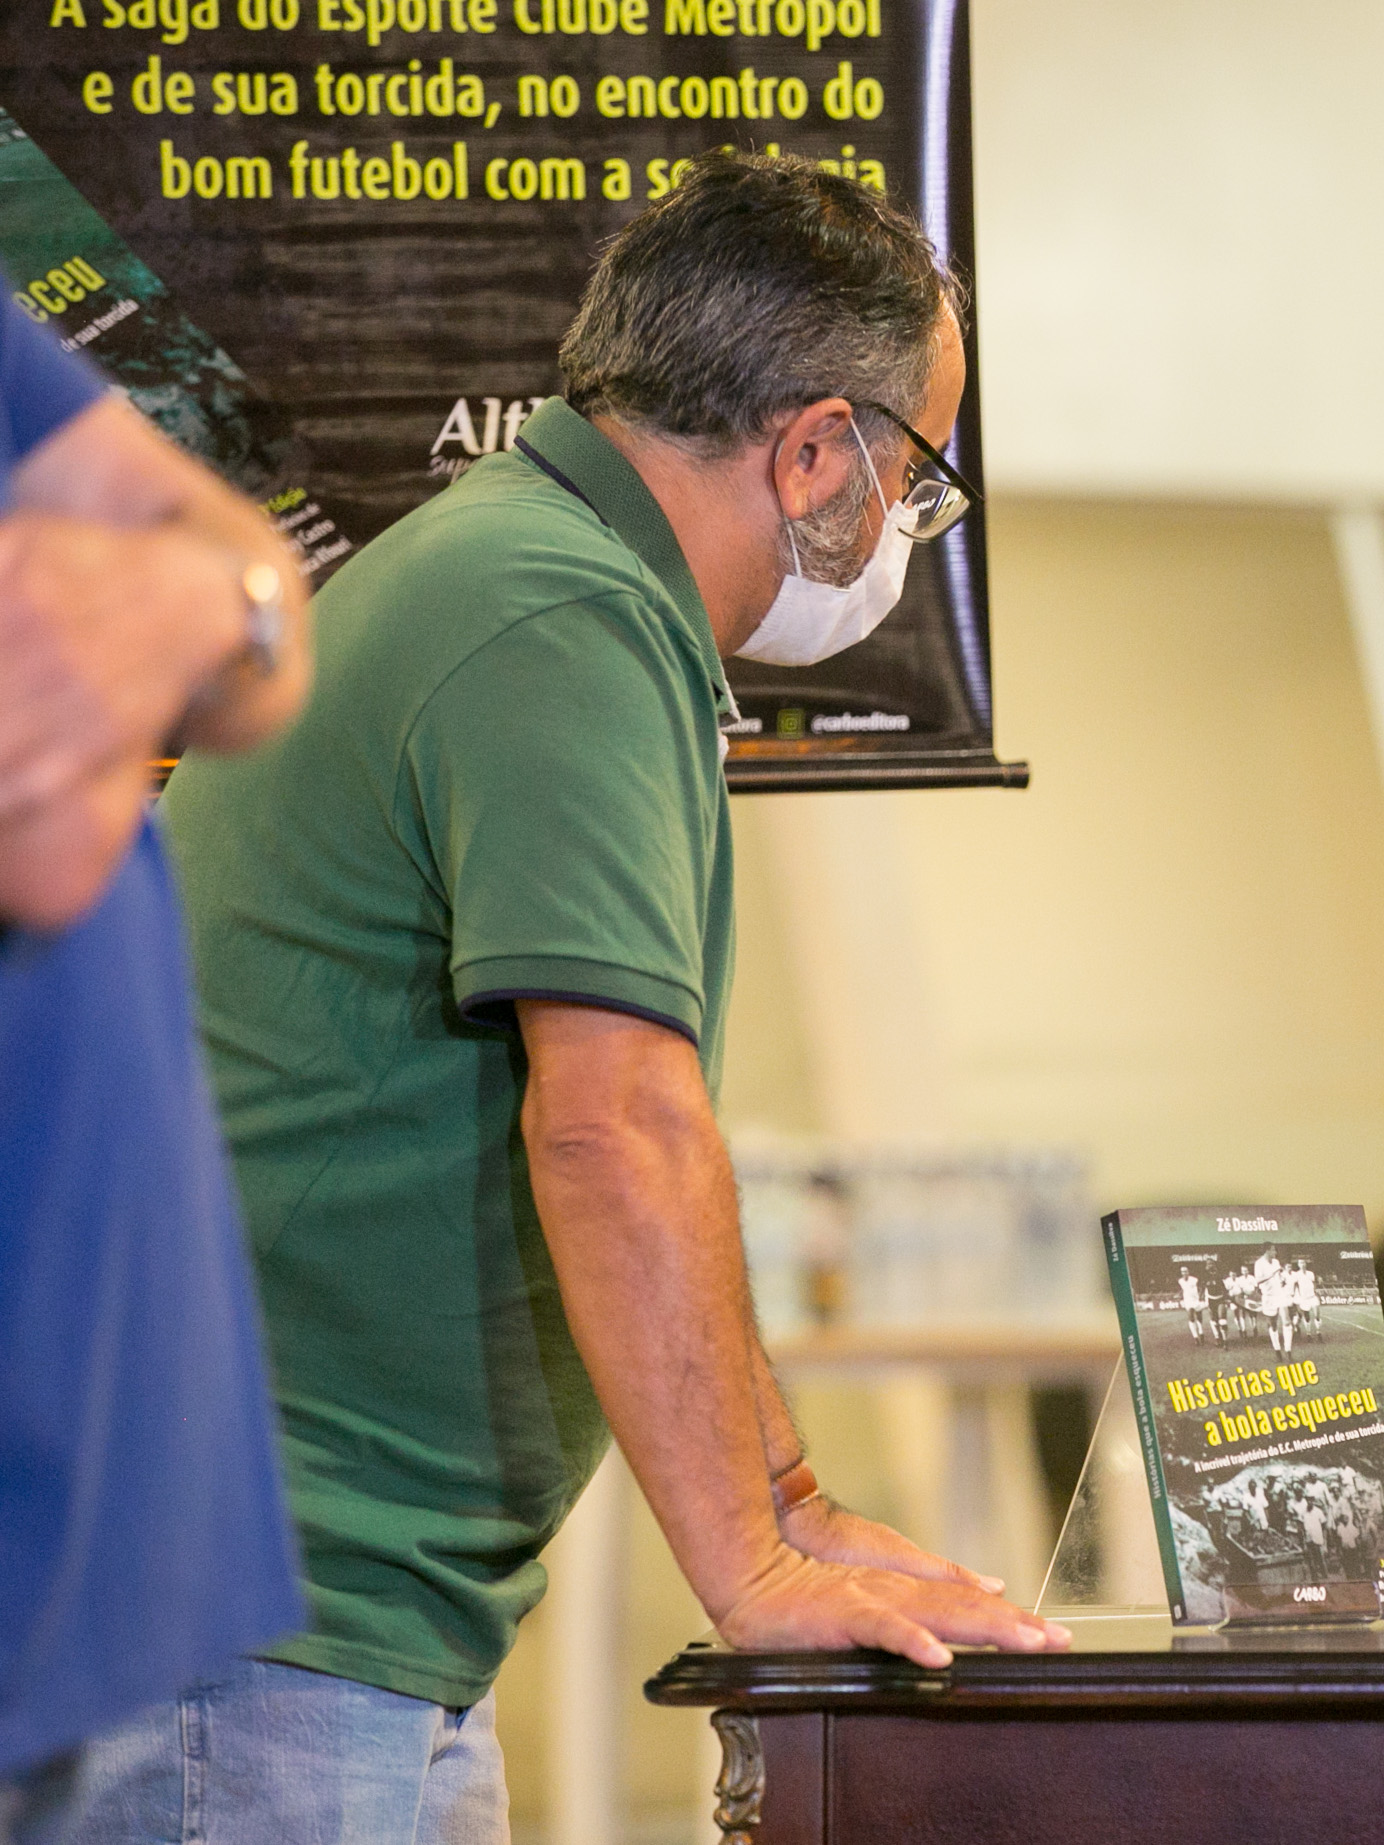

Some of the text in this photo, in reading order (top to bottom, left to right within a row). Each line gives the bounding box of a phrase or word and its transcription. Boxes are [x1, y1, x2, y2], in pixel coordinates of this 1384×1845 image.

[102, 0, 220, 45] saga
[318, 0, 498, 47] Esporte
[513, 0, 650, 35] Clube
[664, 0, 882, 52] Metropol
[83, 54, 885, 129] e de sua torcida, no encontro do
[160, 139, 273, 199] bom
[288, 139, 469, 200] futebol
[485, 157, 587, 201] com
[602, 157, 632, 201] a
[430, 397, 545, 456] Alt
[1216, 1216, 1279, 1232] Zé Dassilva
[1127, 1334, 1142, 1387] esqueceu
[1166, 1360, 1319, 1413] Histórias que
[1136, 1388, 1147, 1415] bola
[1204, 1387, 1378, 1447] a bola esqueceu
[1143, 1425, 1153, 1447] que
[1193, 1461, 1201, 1473] A
[1267, 1445, 1279, 1457] do
[1278, 1441, 1294, 1455] E.C.
[1293, 1433, 1330, 1451] Metropol
[1334, 1431, 1345, 1442] de
[1345, 1429, 1360, 1440] sua
[1293, 1586, 1327, 1602] CARBO
